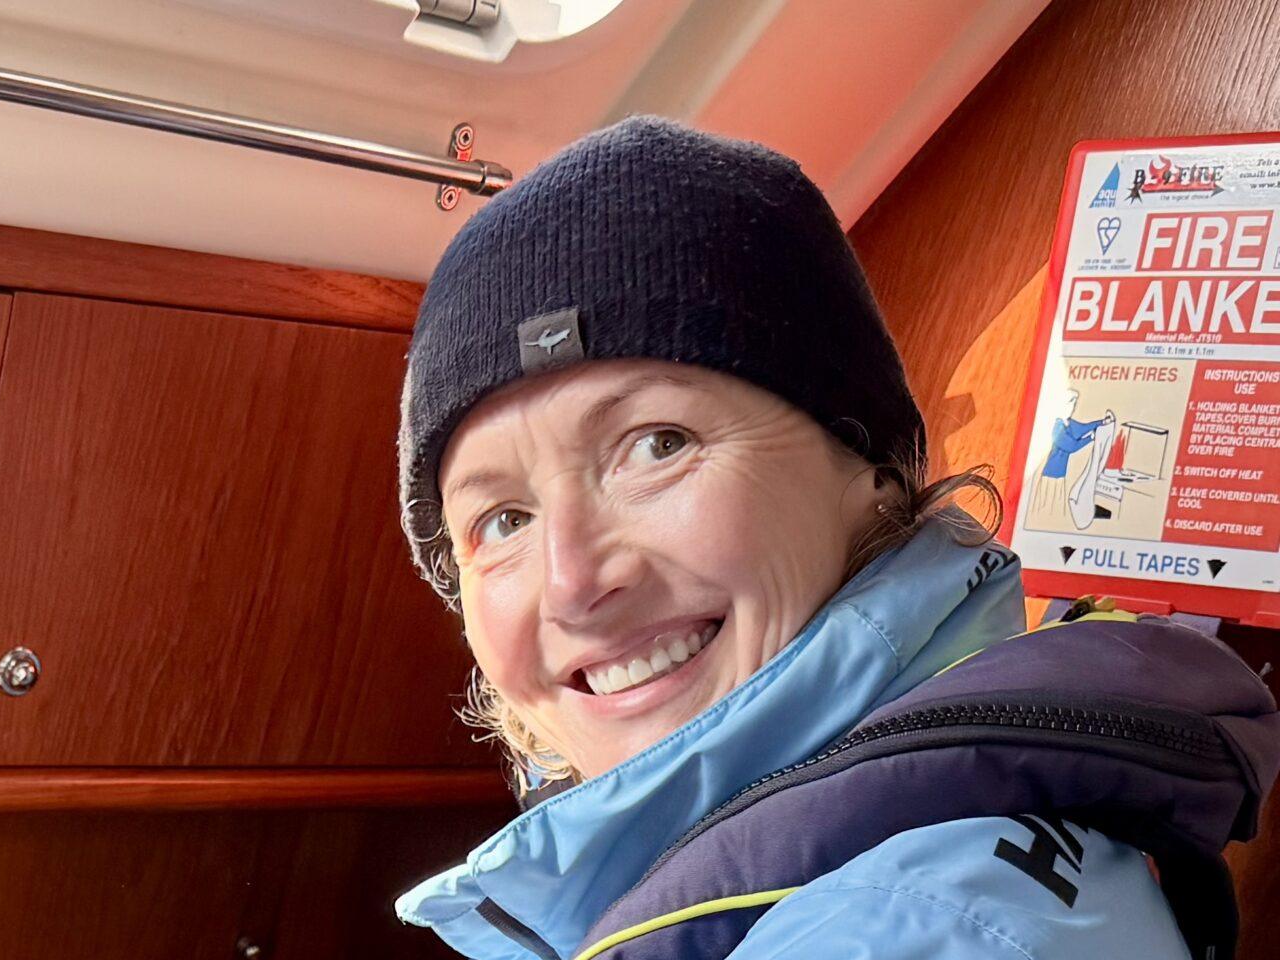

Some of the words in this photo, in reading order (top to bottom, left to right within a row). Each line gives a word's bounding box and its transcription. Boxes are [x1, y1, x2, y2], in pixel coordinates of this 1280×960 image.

[1141, 215, 1268, 269] FIRE
[1066, 280, 1280, 334] BLANKE
[1145, 332, 1177, 342] Material
[1178, 333, 1195, 343] Ref:
[1144, 345, 1165, 355] SIZE:
[1167, 346, 1186, 355] 1.1m
[1195, 346, 1215, 356] 1.1m
[1068, 365, 1131, 381] KITCHEN
[1133, 367, 1179, 382] FIRES
[1204, 369, 1280, 382] INSTRUCTIONS
[1234, 382, 1257, 395] USE
[1197, 401, 1237, 413] HOLDING
[1239, 403, 1280, 415] BLANKET
[1192, 423, 1236, 435] MATERIAL
[1190, 433, 1203, 444] BY
[1203, 434, 1244, 447] PLACING
[1187, 445, 1213, 455] OVER
[1214, 446, 1236, 457] FIRE
[1184, 466, 1218, 478] SWITCH
[1219, 468, 1238, 479] OFF
[1238, 469, 1264, 480] HEAT
[1179, 487, 1208, 499] LEAVE
[1209, 490, 1253, 502] COVERED
[1253, 493, 1280, 505] UNTIL
[1177, 498, 1203, 509] COOL
[1174, 519, 1213, 532] DISCARD
[1213, 523, 1243, 534] AFTER
[1244, 526, 1264, 536] USE
[1081, 548, 1130, 570] PULL
[1136, 553, 1201, 577] TAPES
